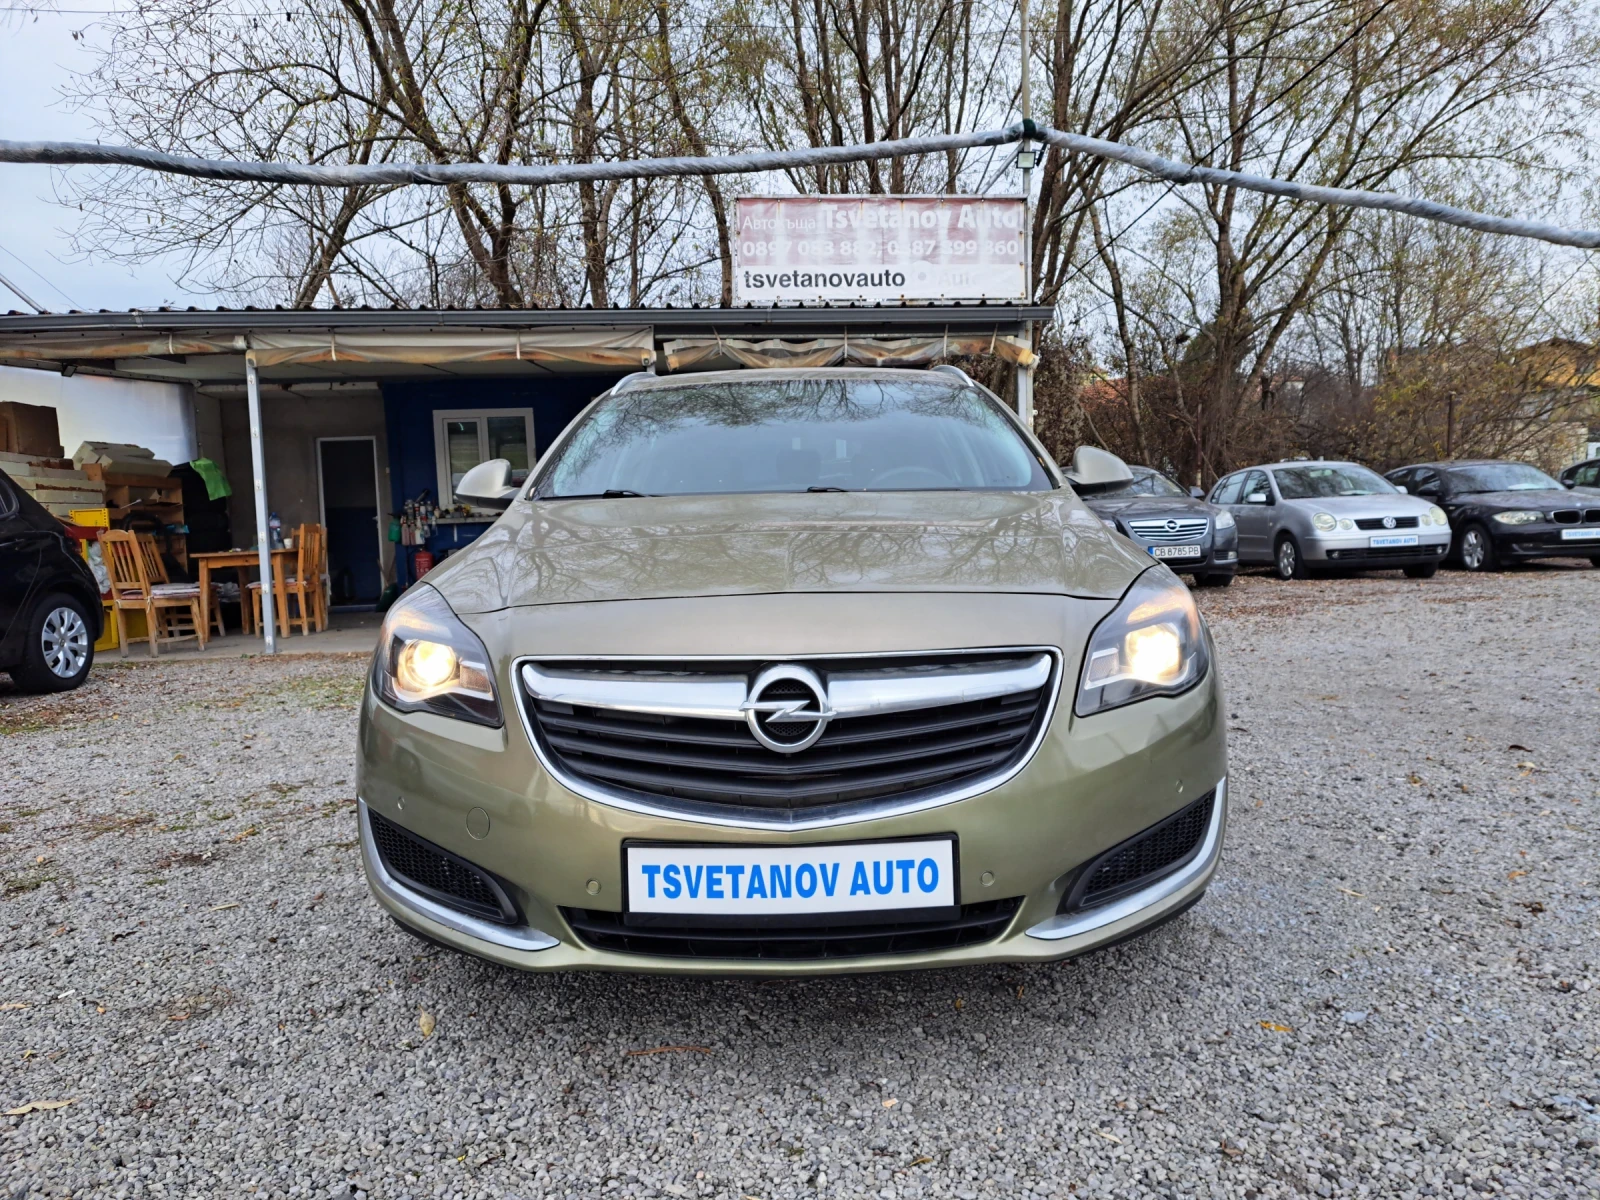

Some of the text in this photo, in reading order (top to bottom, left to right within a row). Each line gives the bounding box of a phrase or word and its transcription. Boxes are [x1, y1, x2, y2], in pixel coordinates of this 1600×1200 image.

[743, 216, 816, 232] Автоъща
[823, 205, 1018, 228] Tsvetanov Auto
[744, 269, 906, 288] tsvetanovauto
[1154, 546, 1199, 557] CB 8785 PB
[641, 857, 939, 900] TSVETANOV AUTO
